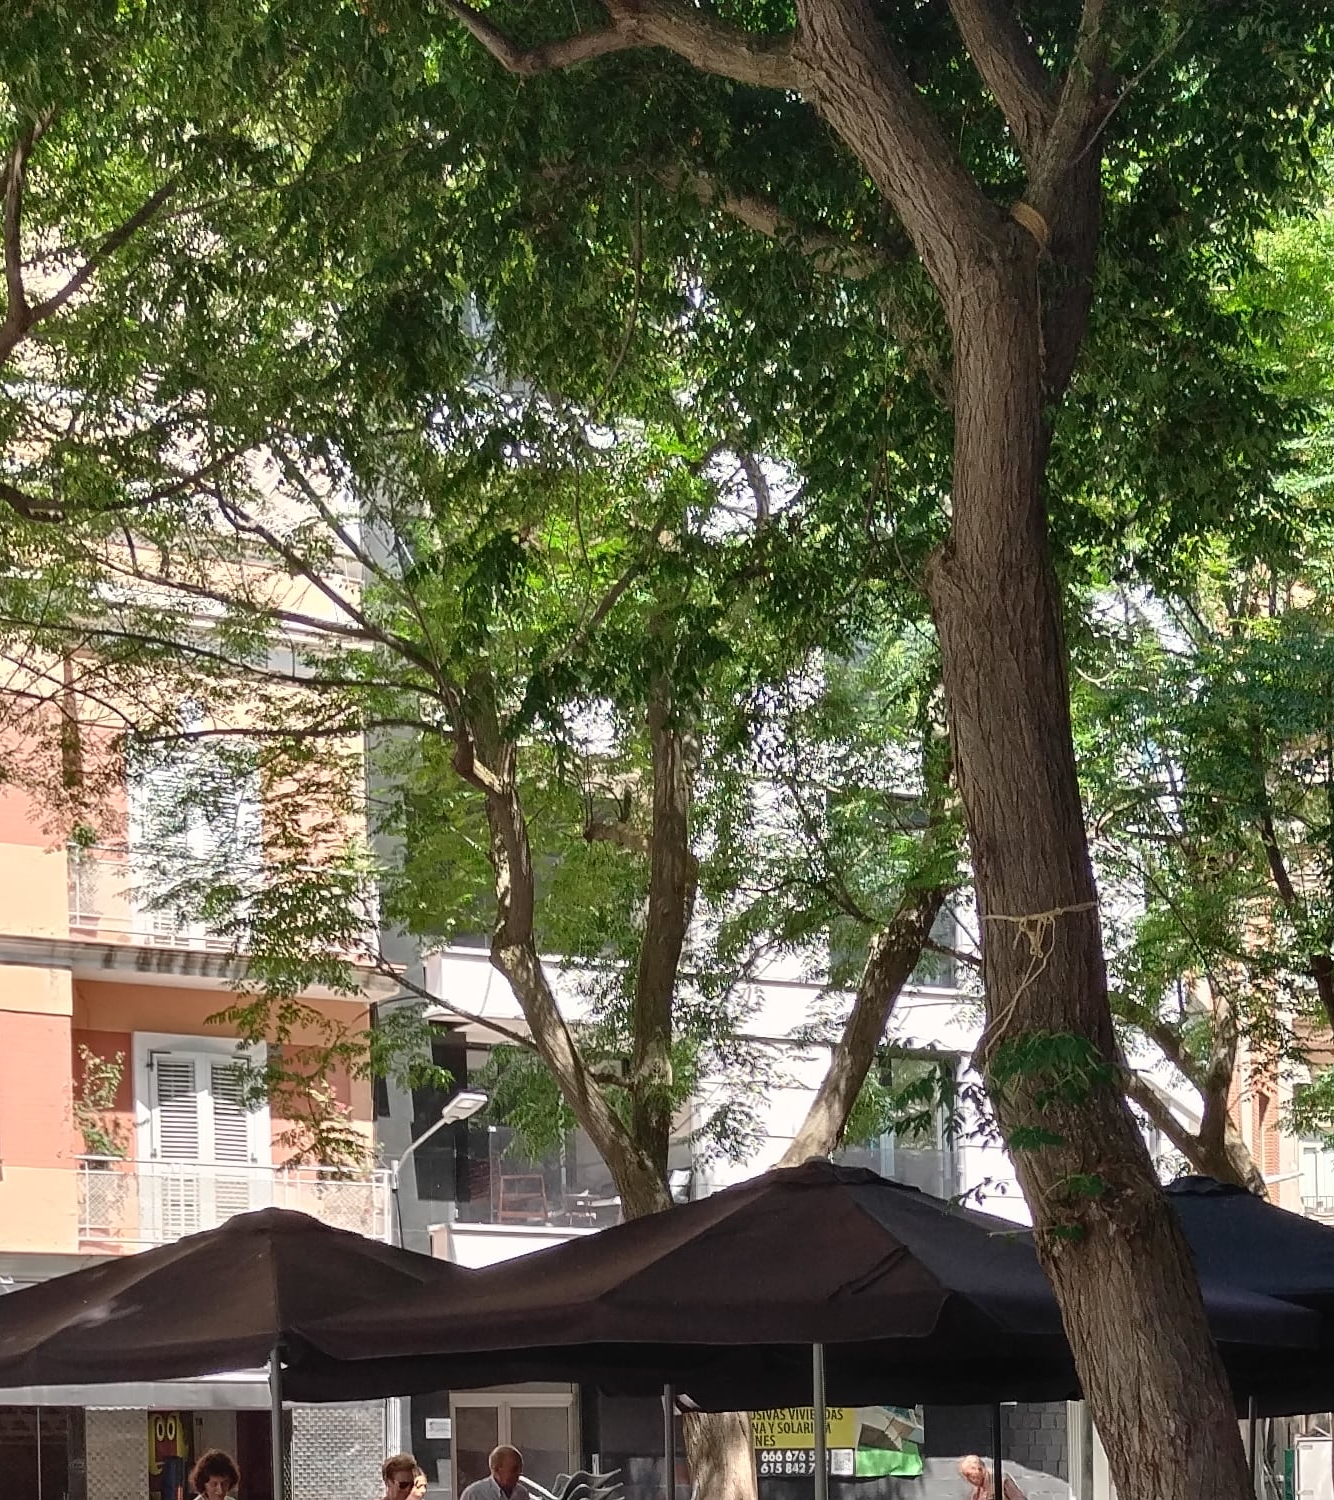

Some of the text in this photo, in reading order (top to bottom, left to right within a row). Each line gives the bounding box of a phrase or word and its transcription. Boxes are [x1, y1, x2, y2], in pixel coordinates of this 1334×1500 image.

[788, 1408, 843, 1421] VIVIEDAS
[768, 1422, 775, 1434] Y
[777, 1421, 832, 1434] SOLARIM
[761, 1450, 783, 1462] 666
[785, 1450, 806, 1462] 676
[760, 1463, 783, 1474] 615
[785, 1463, 806, 1474] 842
